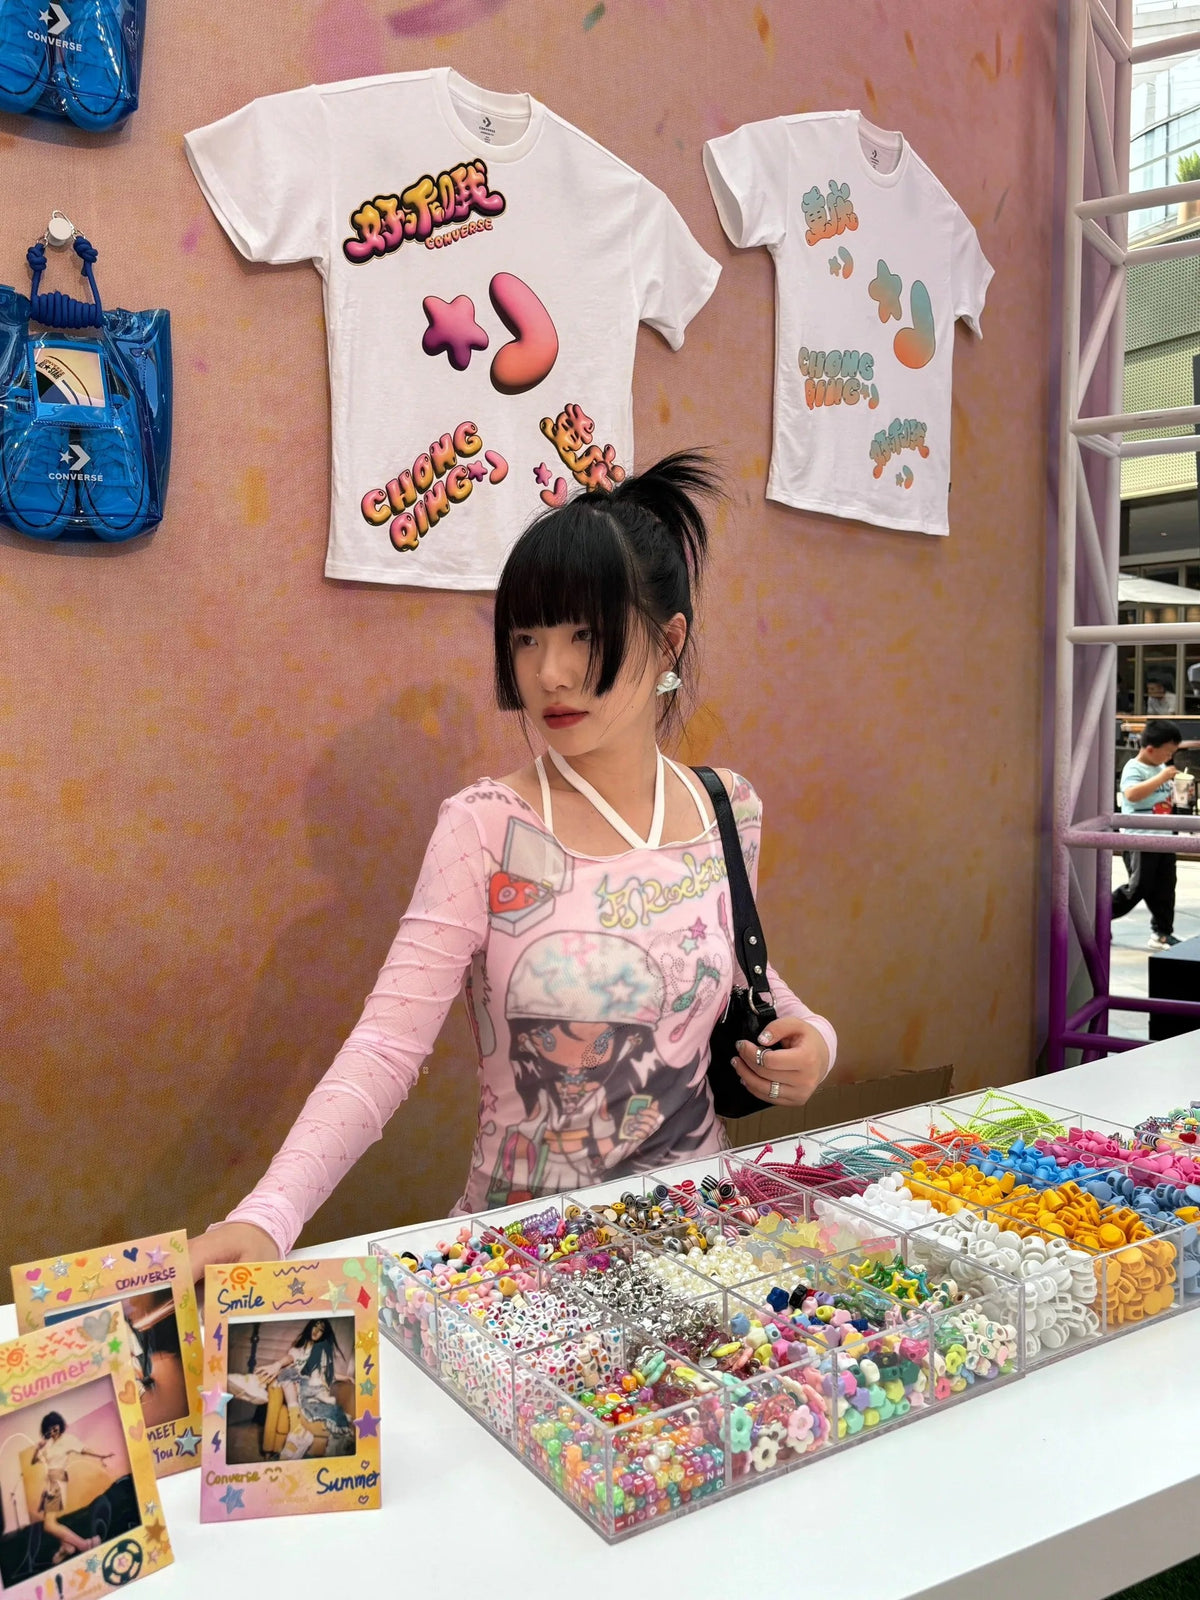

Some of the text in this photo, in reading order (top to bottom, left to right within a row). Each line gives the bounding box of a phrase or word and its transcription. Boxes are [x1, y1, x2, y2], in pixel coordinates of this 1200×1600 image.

[27, 30, 82, 52] CONVERSE
[424, 218, 494, 250] CONVERSE
[798, 346, 875, 381] CHONG
[48, 472, 103, 482] CONVERSE
[361, 420, 483, 526] CHONG
[389, 464, 474, 552] QING
[115, 1267, 176, 1291] CONVERSE
[217, 1287, 265, 1314] Smile
[153, 1447, 174, 1463] You
[206, 1469, 261, 1486] Converse
[316, 1467, 381, 1494] Summer
